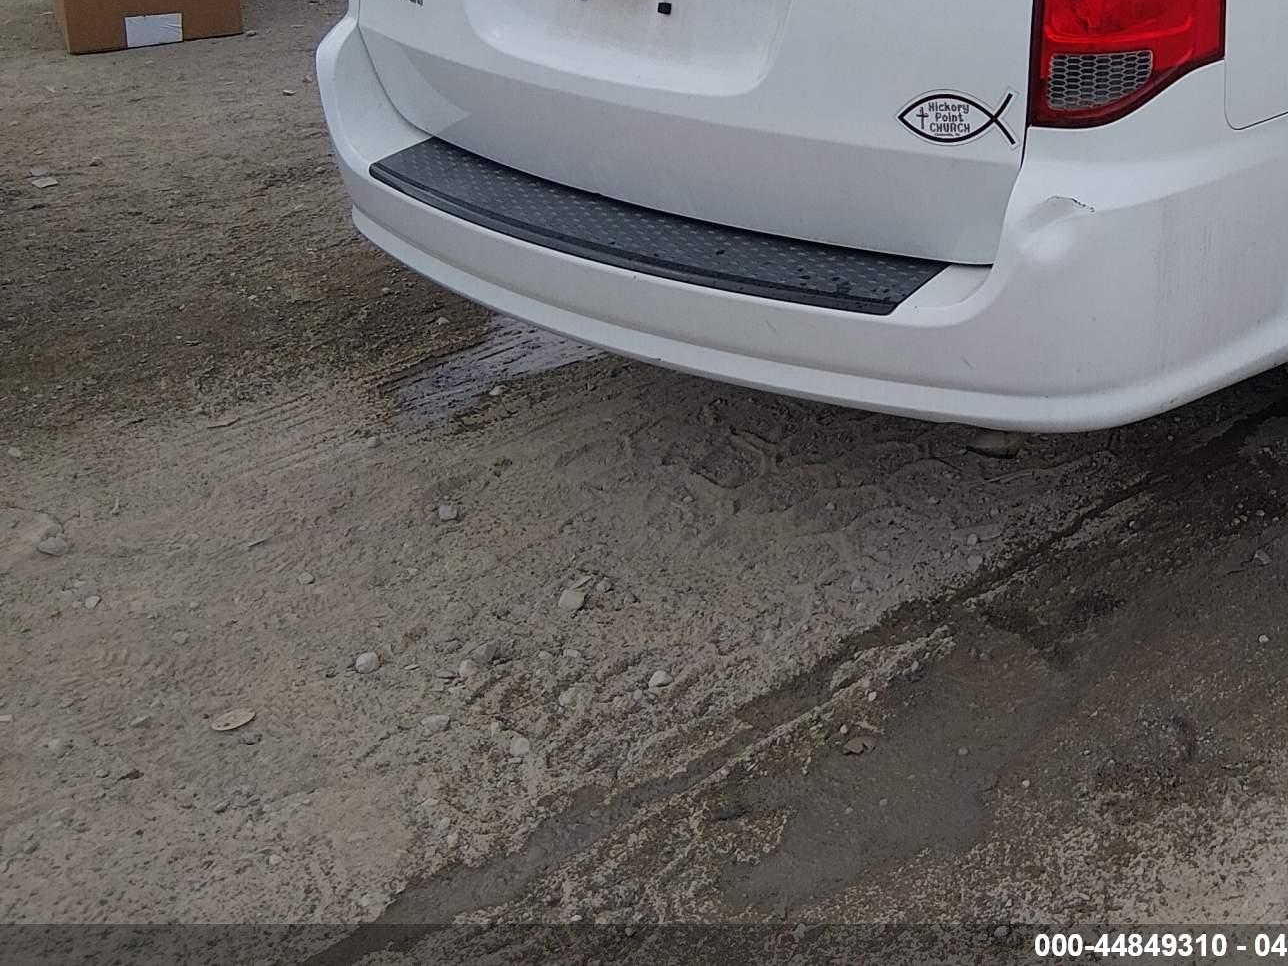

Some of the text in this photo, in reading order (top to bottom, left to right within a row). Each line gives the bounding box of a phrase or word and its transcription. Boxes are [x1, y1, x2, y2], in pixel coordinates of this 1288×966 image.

[928, 101, 970, 114] Hickory
[935, 113, 964, 122] Point
[929, 122, 971, 133] CHURCH
